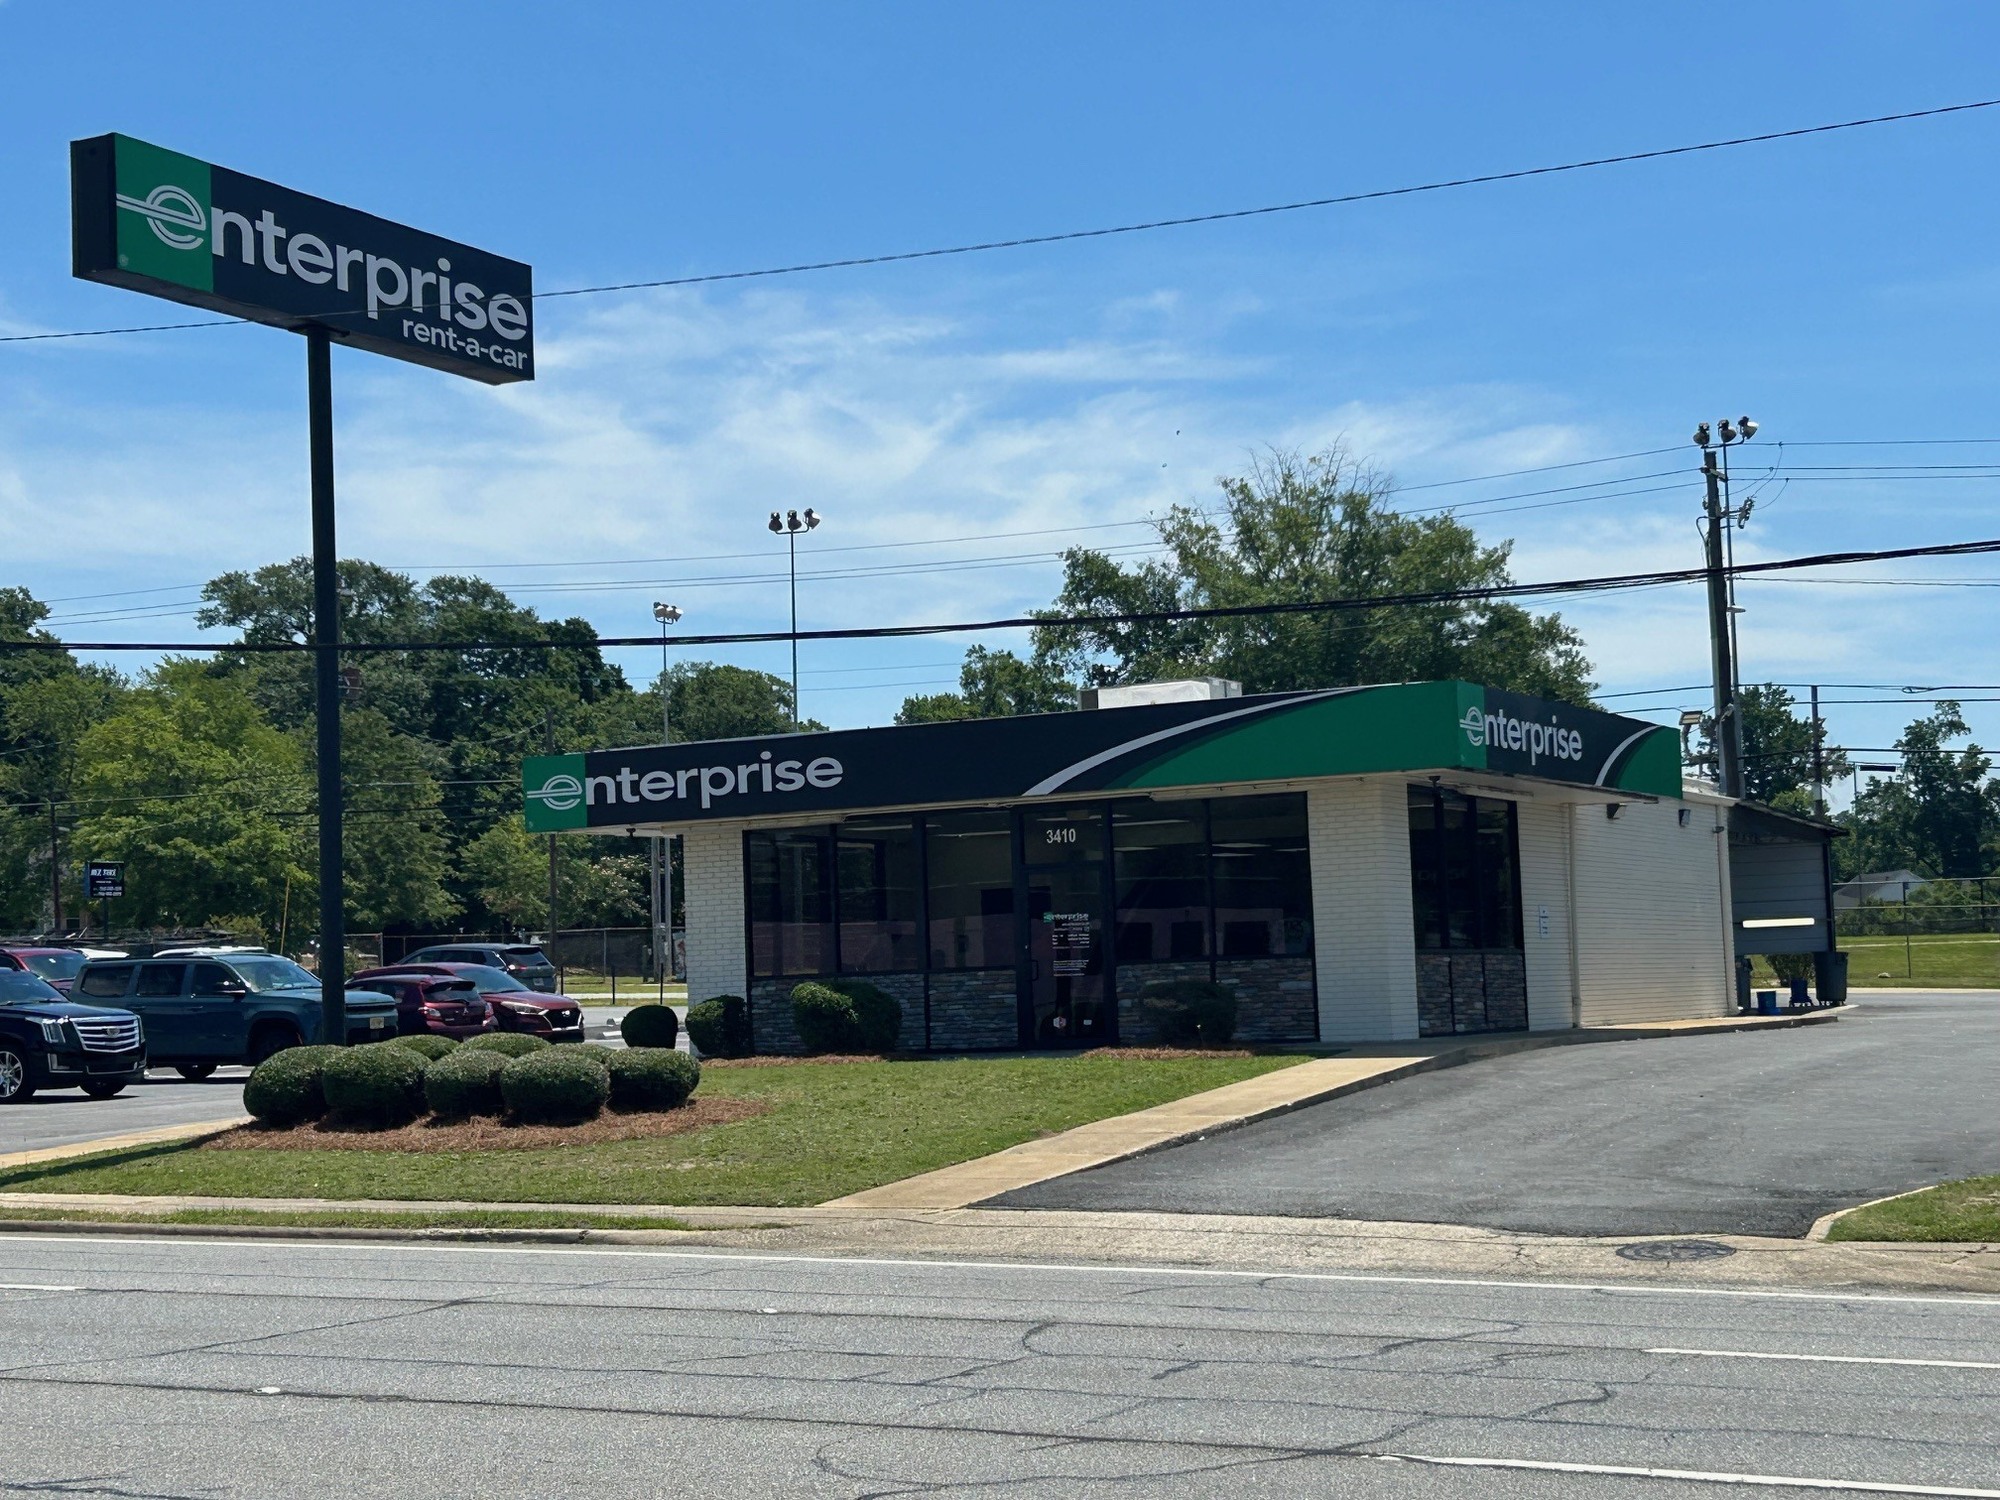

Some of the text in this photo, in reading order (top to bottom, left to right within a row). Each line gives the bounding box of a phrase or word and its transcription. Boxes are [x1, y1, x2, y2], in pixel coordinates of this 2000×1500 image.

[116, 185, 528, 340] enterprise
[402, 318, 528, 370] rent-a-car
[1459, 706, 1583, 766] enterprise
[527, 751, 844, 811] enterprise
[1046, 828, 1076, 844] 3410
